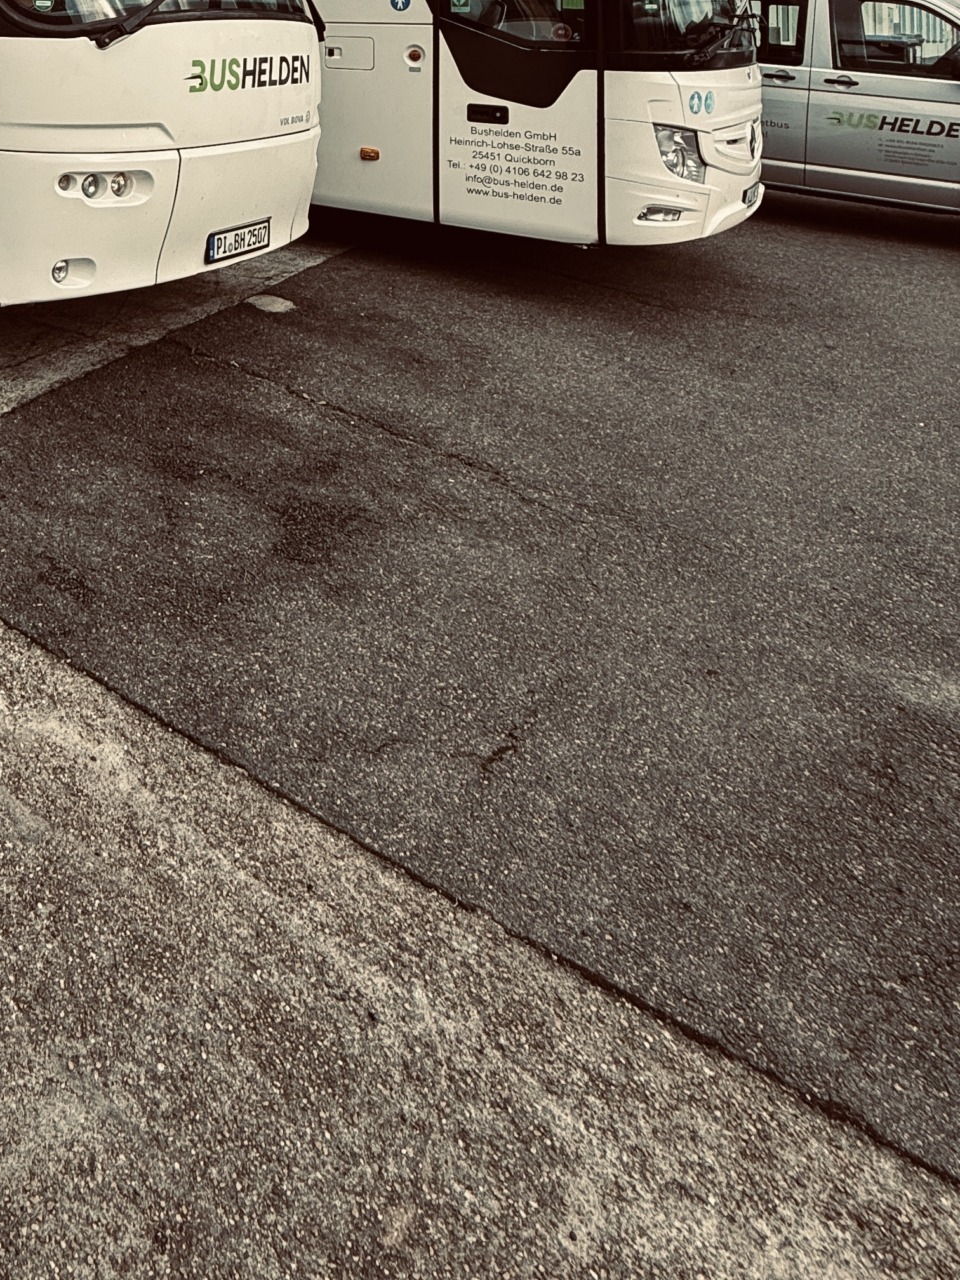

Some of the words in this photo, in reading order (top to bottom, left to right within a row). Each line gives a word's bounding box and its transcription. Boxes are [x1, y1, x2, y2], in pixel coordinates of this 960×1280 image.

[183, 55, 310, 93] BUSHELDEN
[470, 126, 522, 139] Bushelden
[524, 130, 557, 142] GmbH
[449, 136, 559, 154] Heinrich-Lohse-Straße
[561, 146, 581, 157] 55a
[472, 150, 501, 161] 25451
[504, 153, 556, 167] Quickborn
[469, 162, 487, 172] +49
[489, 164, 503, 175] (0)
[505, 166, 530, 177] 4106
[533, 168, 552, 179] 642
[555, 171, 568, 181] 98
[571, 172, 585, 183] 23
[465, 173, 564, 193] info@bus-helden.de
[466, 187, 563, 206] www.bus-helden.de
[216, 235, 227, 256] PI
[234, 230, 246, 252] BH
